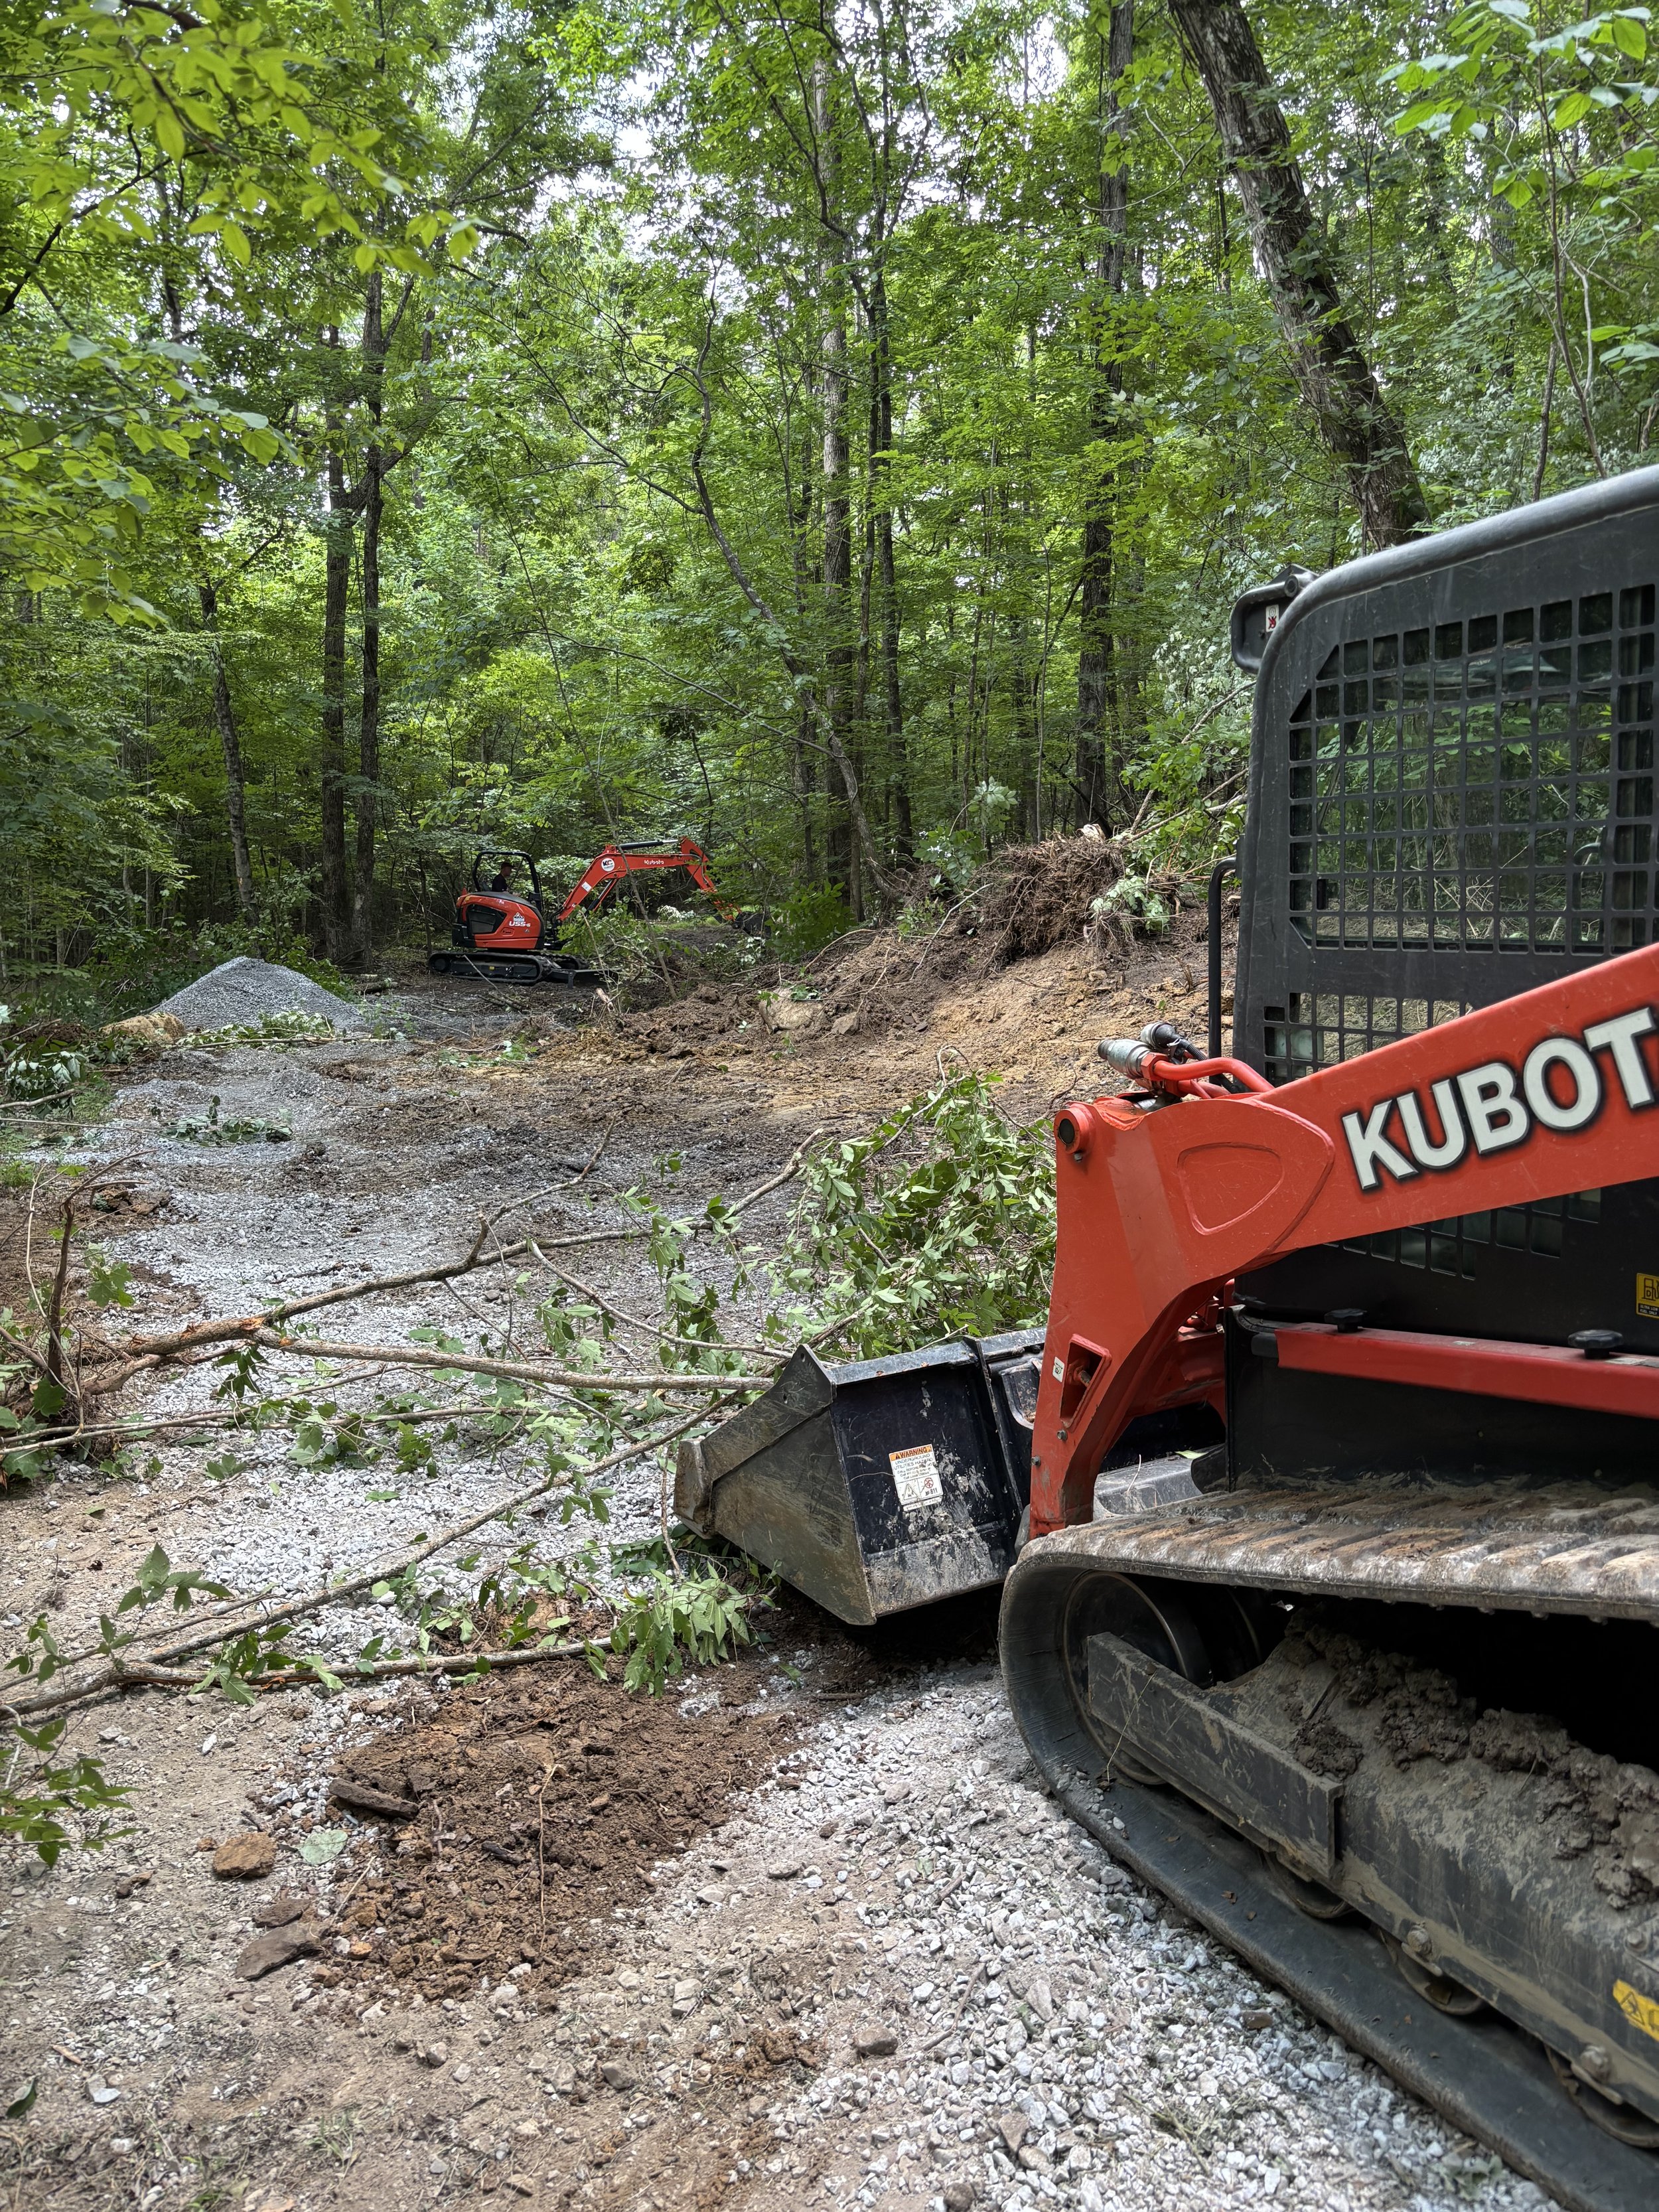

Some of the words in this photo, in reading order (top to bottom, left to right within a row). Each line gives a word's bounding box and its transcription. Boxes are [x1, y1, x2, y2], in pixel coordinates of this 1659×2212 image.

[1342, 1006, 1659, 1191] KUBOT
[900, 1447, 928, 1457] WARNING
[895, 1453, 930, 1465] UNDERGROUND
